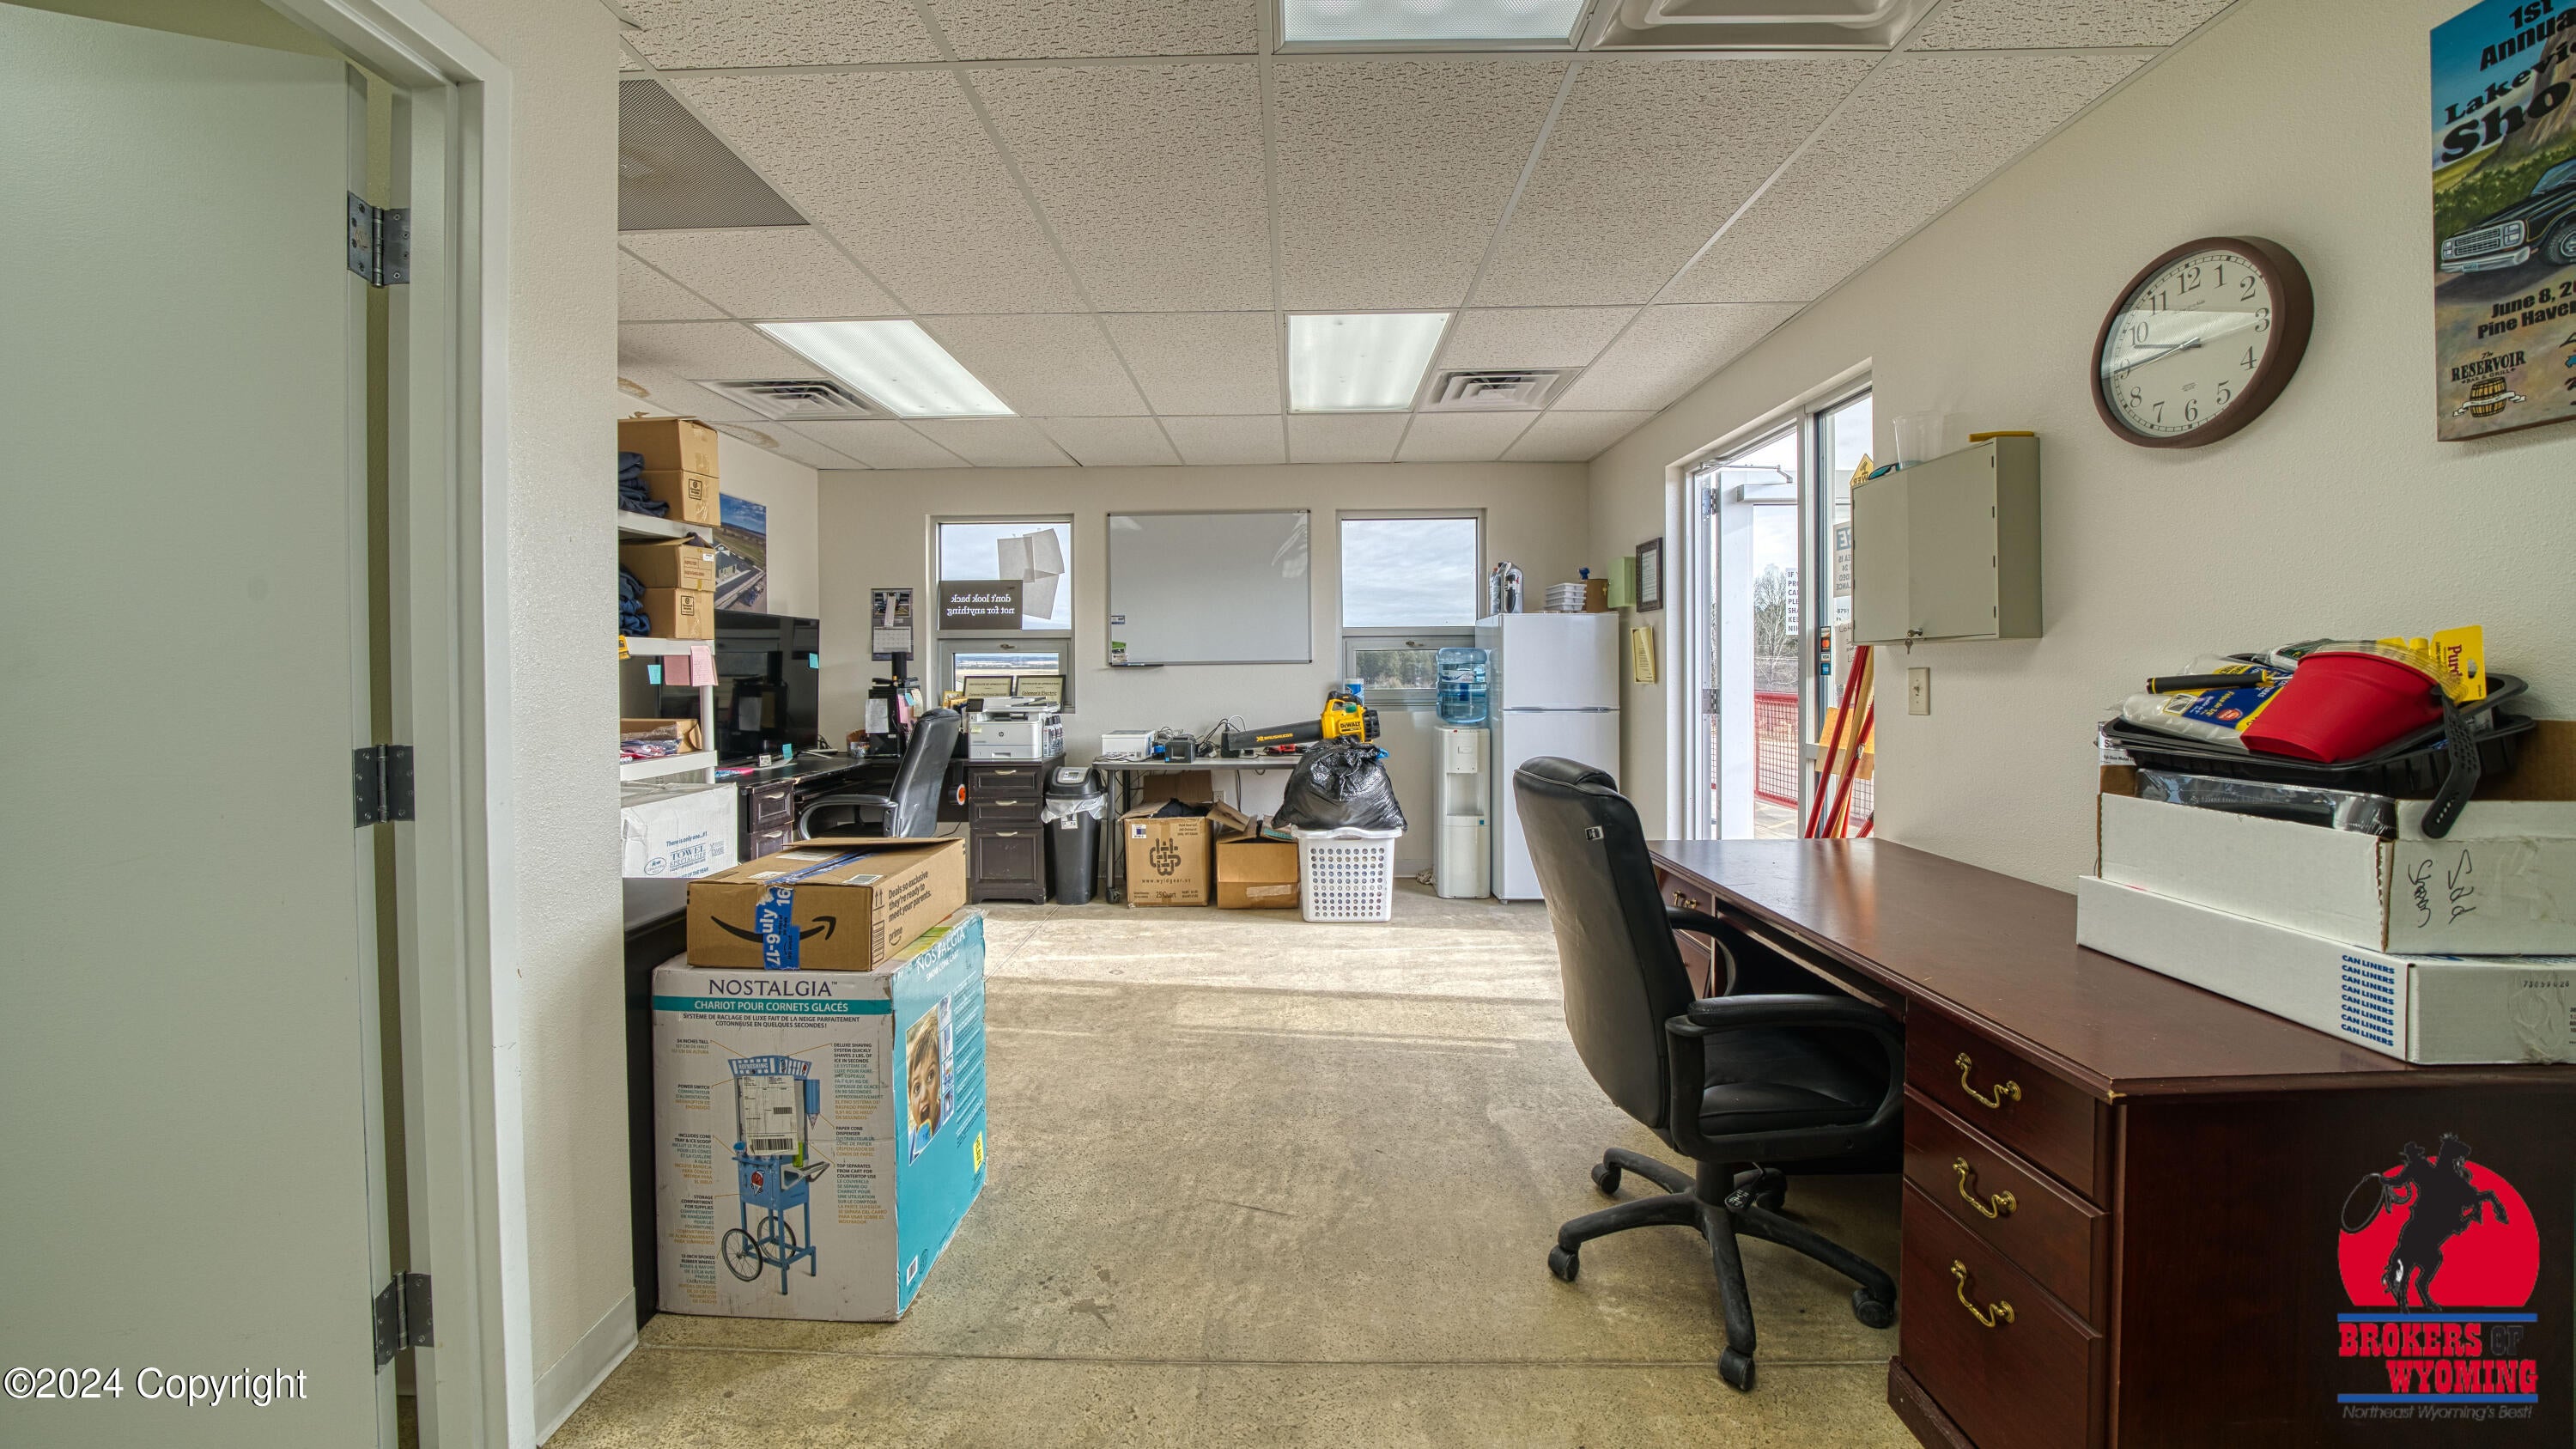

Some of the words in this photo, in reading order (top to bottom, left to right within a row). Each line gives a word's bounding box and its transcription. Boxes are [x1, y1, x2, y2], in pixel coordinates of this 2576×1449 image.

[2509, 0, 2554, 29] 1st
[2441, 73, 2576, 162] Sho
[2177, 266, 2202, 295] 12
[2214, 264, 2227, 289] 1
[2239, 276, 2256, 301] 2
[2491, 295, 2535, 318] June
[2538, 288, 2556, 303] 8,
[2559, 280, 2576, 298] 2
[2148, 290, 2168, 317] 11
[2254, 307, 2269, 332] 3
[2477, 318, 2518, 339] Pine
[2129, 321, 2149, 346] 10
[2239, 345, 2257, 370] 4
[2451, 350, 2526, 382] RESERVOIR
[2129, 386, 2142, 408] 8
[2216, 381, 2231, 405] 5
[2153, 401, 2165, 423] 7
[2184, 399, 2198, 422] 6
[889, 885, 902, 899] Deals
[908, 871, 928, 888] exclusive
[907, 886, 920, 899] ready
[776, 889, 791, 906] 16
[760, 908, 778, 934] uly
[889, 908, 902, 922] meet
[902, 901, 913, 916] your
[2342, 955, 2360, 965] CAN
[2362, 960, 2395, 974] LINERS
[2342, 965, 2360, 975] CAN
[2362, 971, 2395, 984] LINERS
[2342, 974, 2360, 984] CAN
[2362, 980, 2394, 995] LINERS
[2342, 984, 2360, 995] CAN
[2362, 990, 2394, 1005] LINERS
[695, 1001, 736, 1011] CHARIOT
[738, 1002, 764, 1011] POUR
[766, 1002, 809, 1012] CORNETS
[811, 1002, 848, 1013] GLACÉS
[2342, 995, 2360, 1005] CAN
[2361, 1001, 2394, 1015] LINERS
[2342, 1004, 2360, 1014] CAN
[2361, 1010, 2394, 1026] LINERS
[2341, 1024, 2360, 1034] CAN
[2361, 1031, 2394, 1046] LINERS
[2342, 1014, 2360, 1025] CAN
[2361, 1020, 2394, 1036] LINERS
